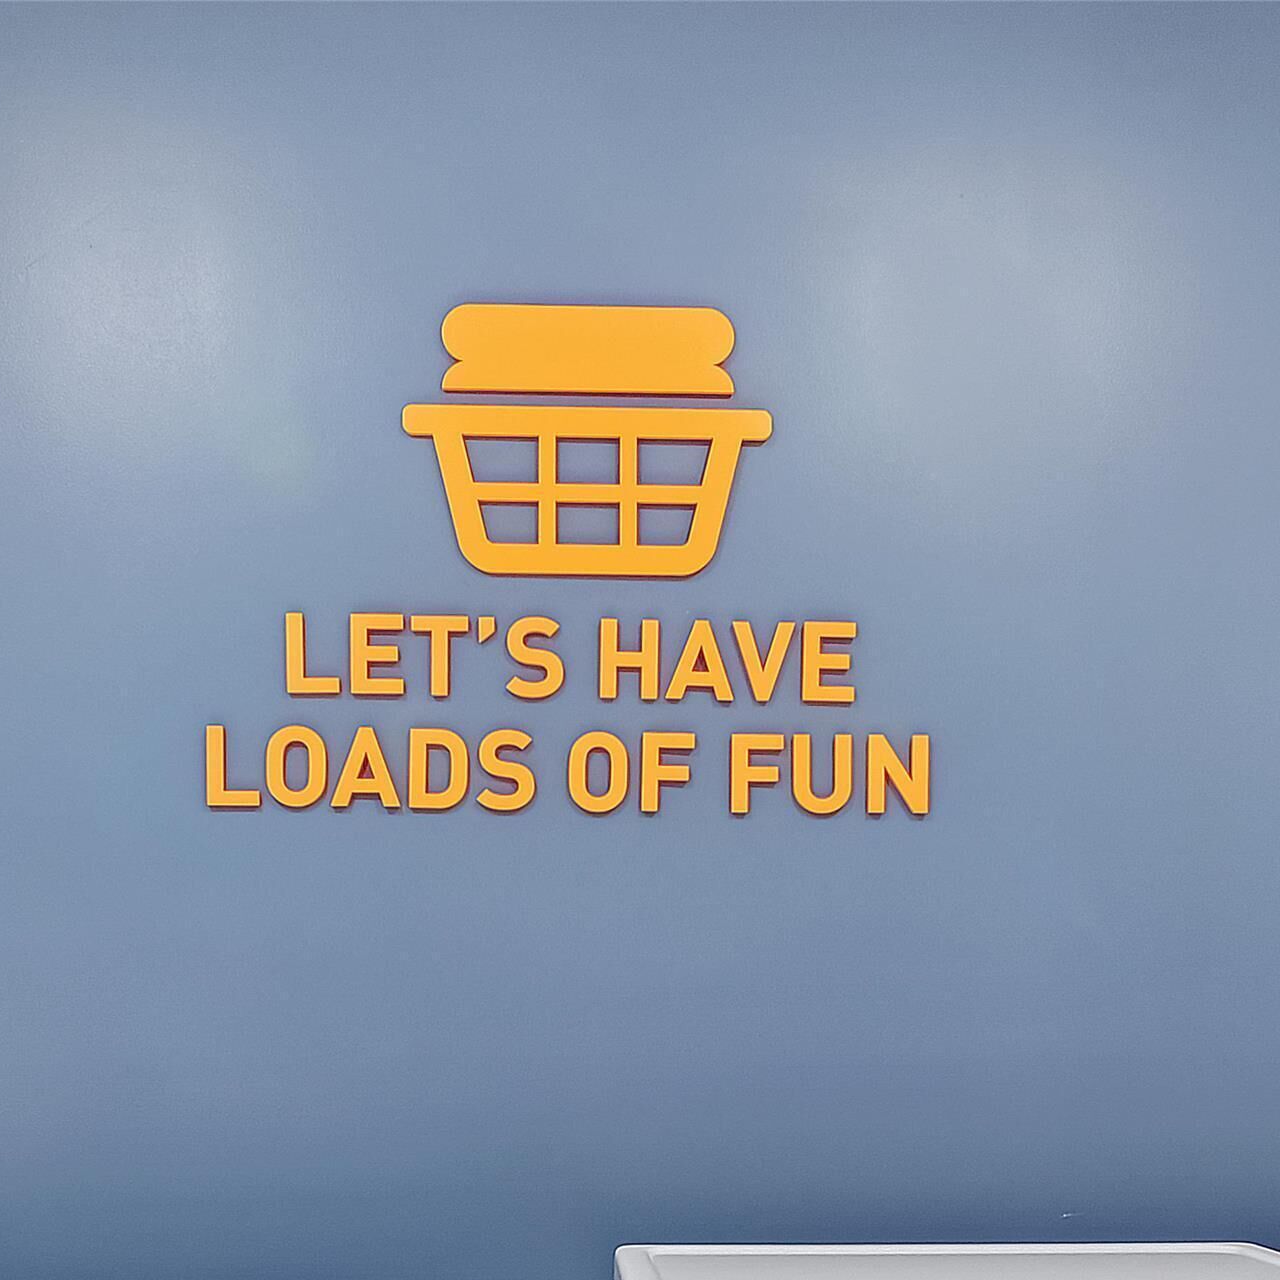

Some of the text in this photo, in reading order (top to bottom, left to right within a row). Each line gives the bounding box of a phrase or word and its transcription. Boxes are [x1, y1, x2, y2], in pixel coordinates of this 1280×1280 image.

[284, 611, 858, 704] LET'S HAVE
[205, 724, 931, 816] LOADS OF FUN
